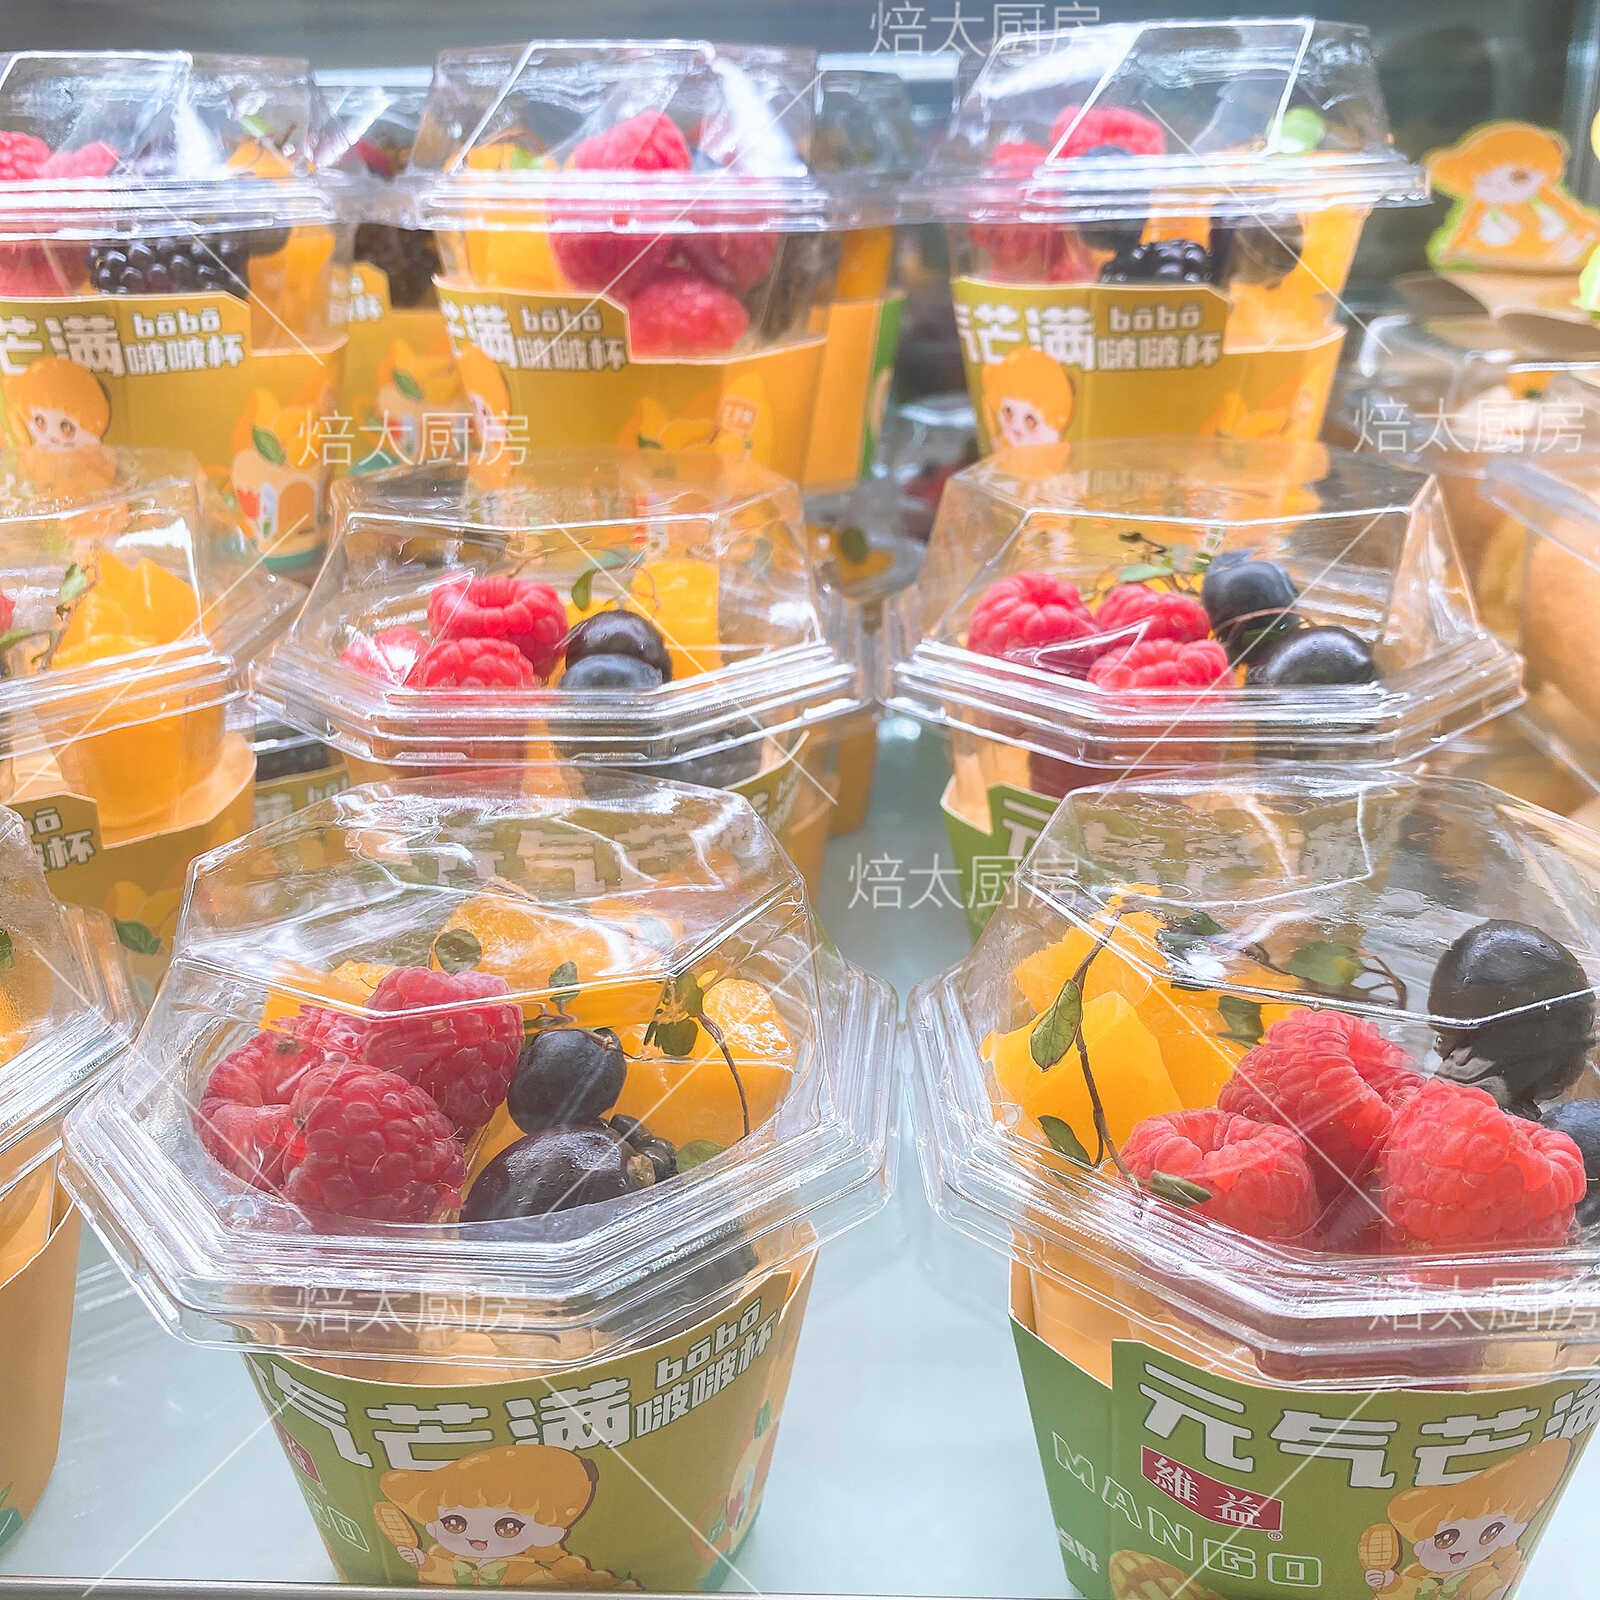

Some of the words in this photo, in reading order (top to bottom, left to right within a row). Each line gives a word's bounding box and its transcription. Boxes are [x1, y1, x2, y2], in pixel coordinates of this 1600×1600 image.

[634, 1310, 779, 1439] 啵啵杯
[1051, 1431, 1323, 1589] MANGO
[1152, 1456, 1263, 1529] 維益
